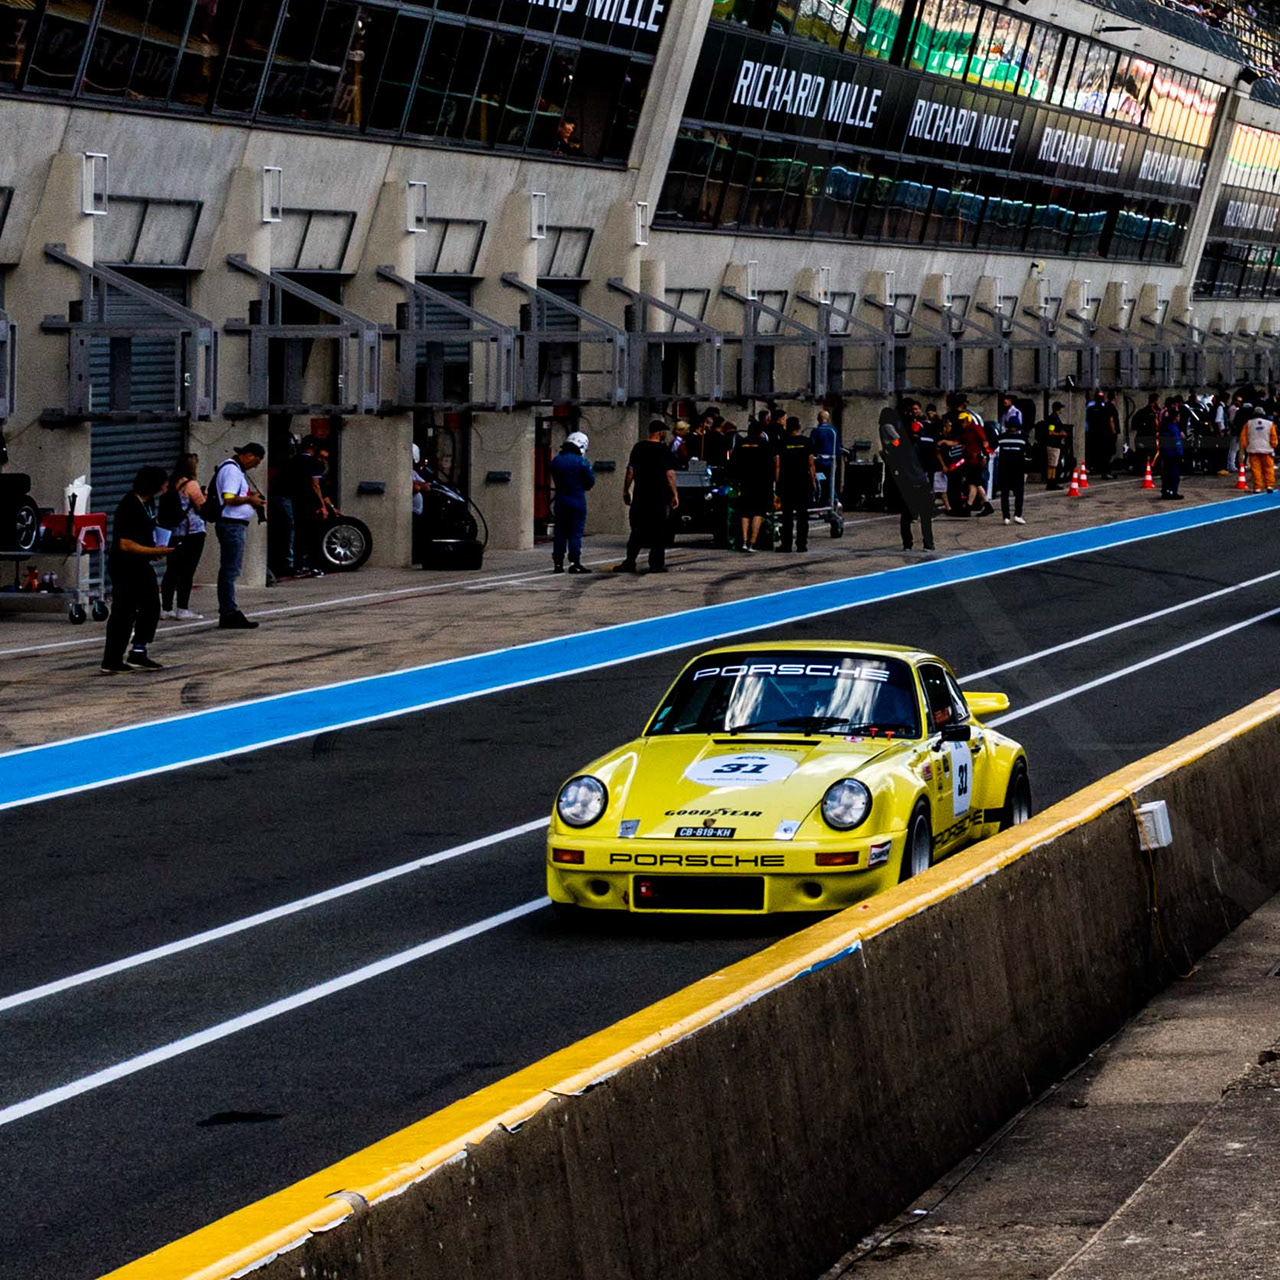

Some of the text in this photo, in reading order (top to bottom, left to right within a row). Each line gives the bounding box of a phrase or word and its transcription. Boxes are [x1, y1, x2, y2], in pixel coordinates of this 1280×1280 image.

[733, 60, 882, 129] RICHARD MILLE
[909, 99, 1019, 153] RICHARD MILLE
[1038, 127, 1126, 174] RICHARD MILLE
[693, 664, 890, 682] PORSCHE
[713, 763, 770, 774] 31
[957, 763, 968, 797] 31
[609, 853, 785, 867] PORSCHE
